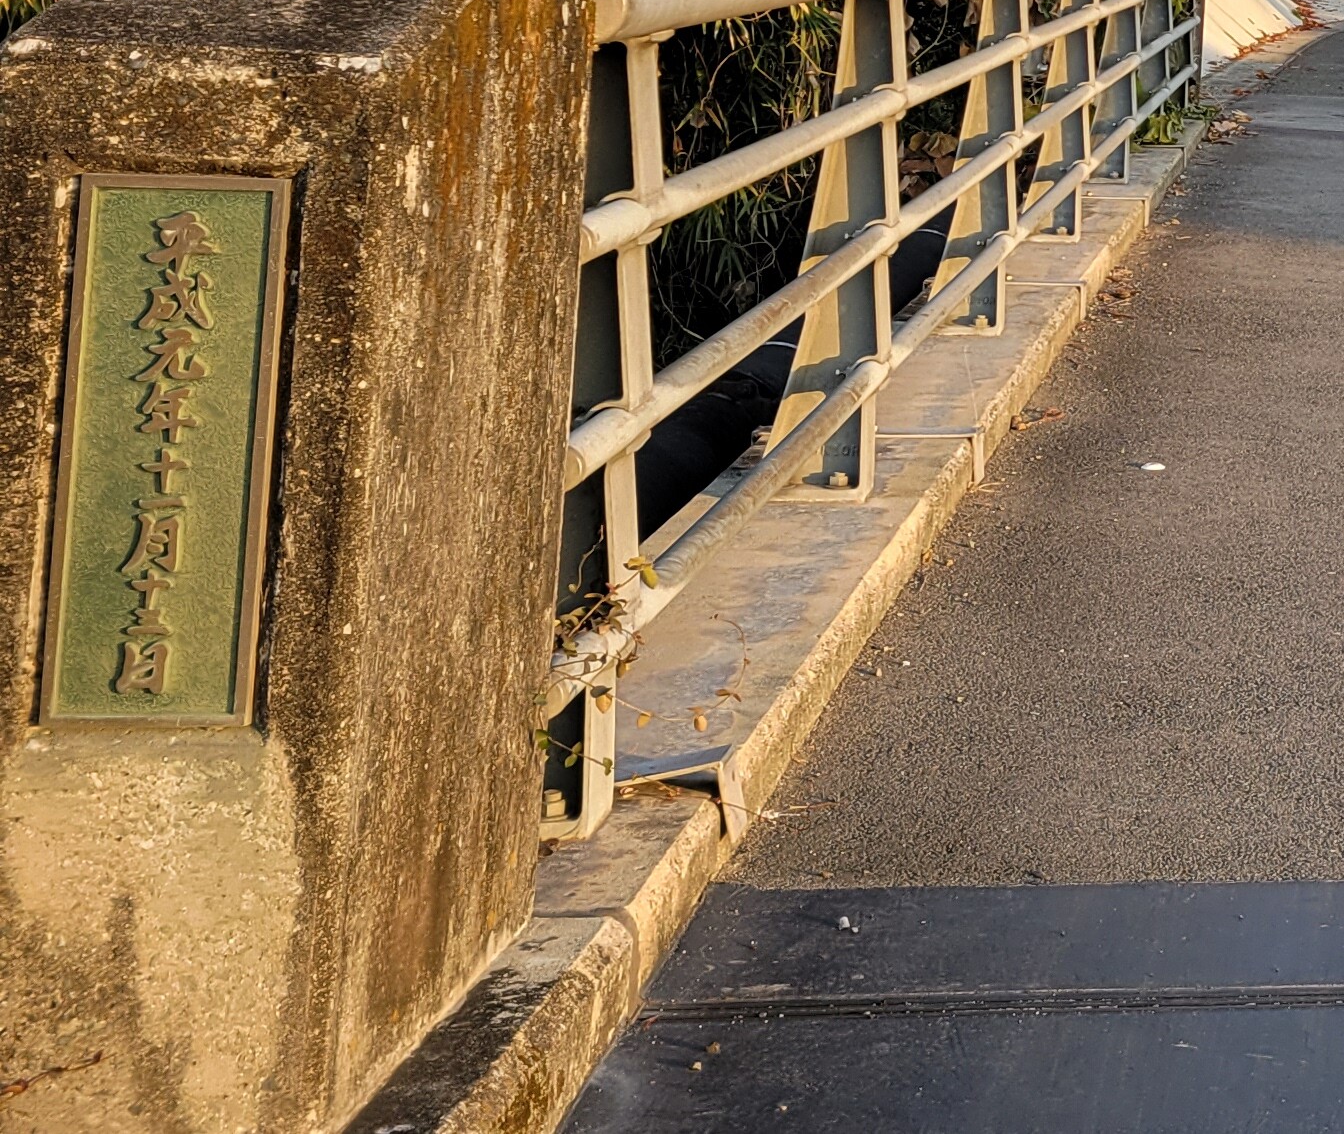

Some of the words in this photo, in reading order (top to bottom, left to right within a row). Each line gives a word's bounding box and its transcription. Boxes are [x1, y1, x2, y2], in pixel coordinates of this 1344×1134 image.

[116, 210, 212, 694] 平成元年十一月十三日
